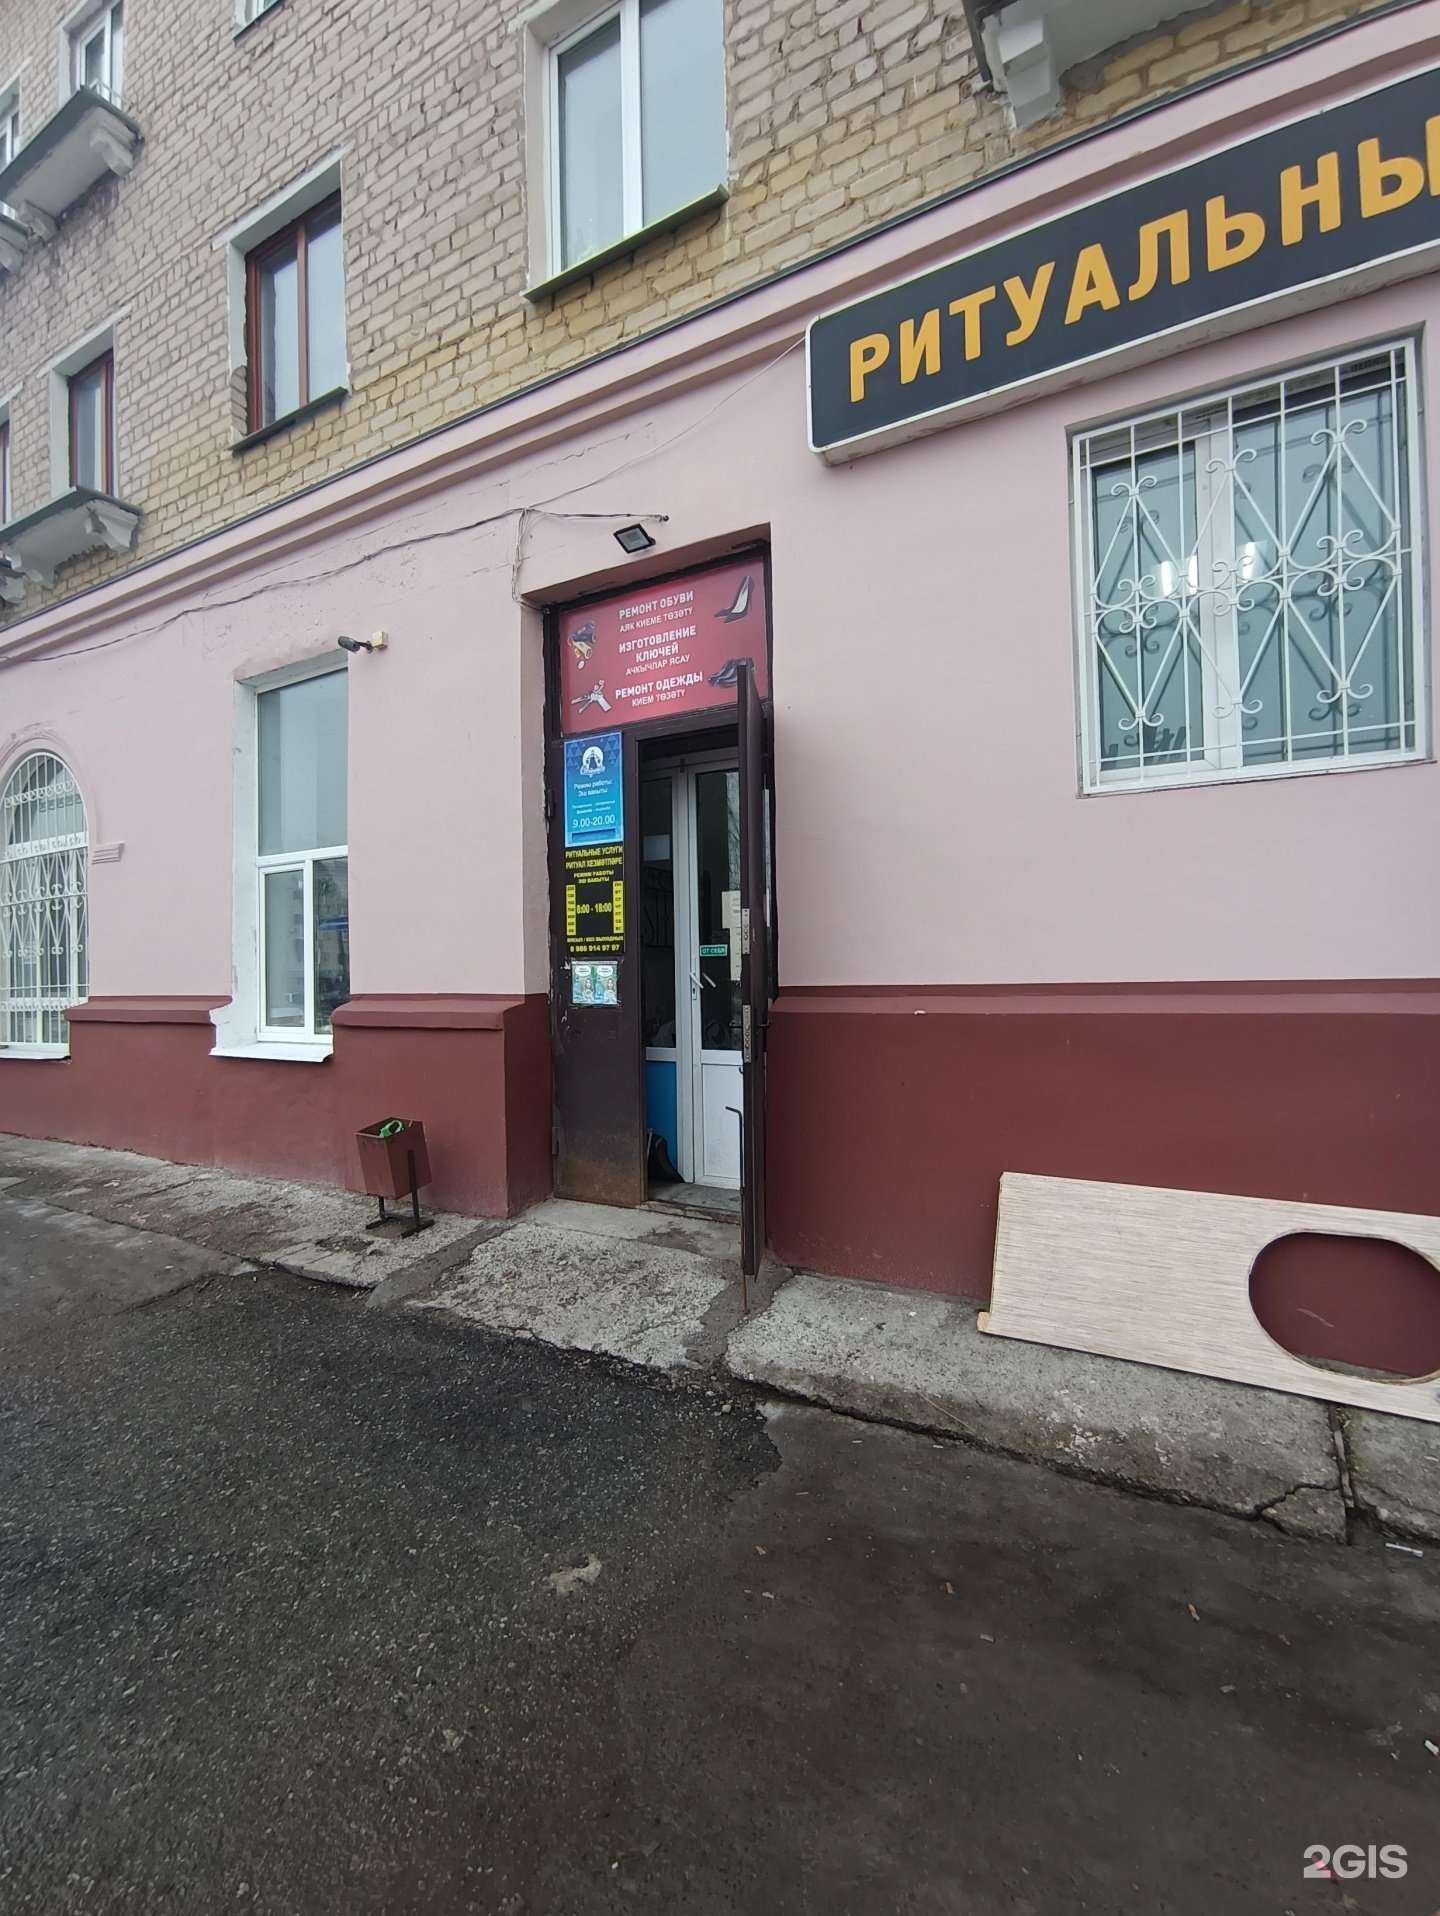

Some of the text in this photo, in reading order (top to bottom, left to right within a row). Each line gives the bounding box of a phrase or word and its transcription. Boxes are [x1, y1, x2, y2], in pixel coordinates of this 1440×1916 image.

[619, 590, 694, 620] РЕМОНТ ОБУВИ
[620, 623, 635, 633] АЯК
[635, 615, 662, 629] КИЕМЕ
[619, 625, 697, 654] ИЗГОТОВЛЕНИЕ
[635, 641, 679, 663] КЛЮЧЕЙ
[625, 654, 690, 676] АЧКЫЧЛАР ЯСАУ
[615, 671, 703, 699] РЕМОНТ ОДЕЖДЫ
[631, 695, 655, 707] КИЕМ
[565, 845, 623, 859] РИТУАЛЬНЫЕ УСЛУГИ
[565, 860, 586, 870] РИТУАЛ
